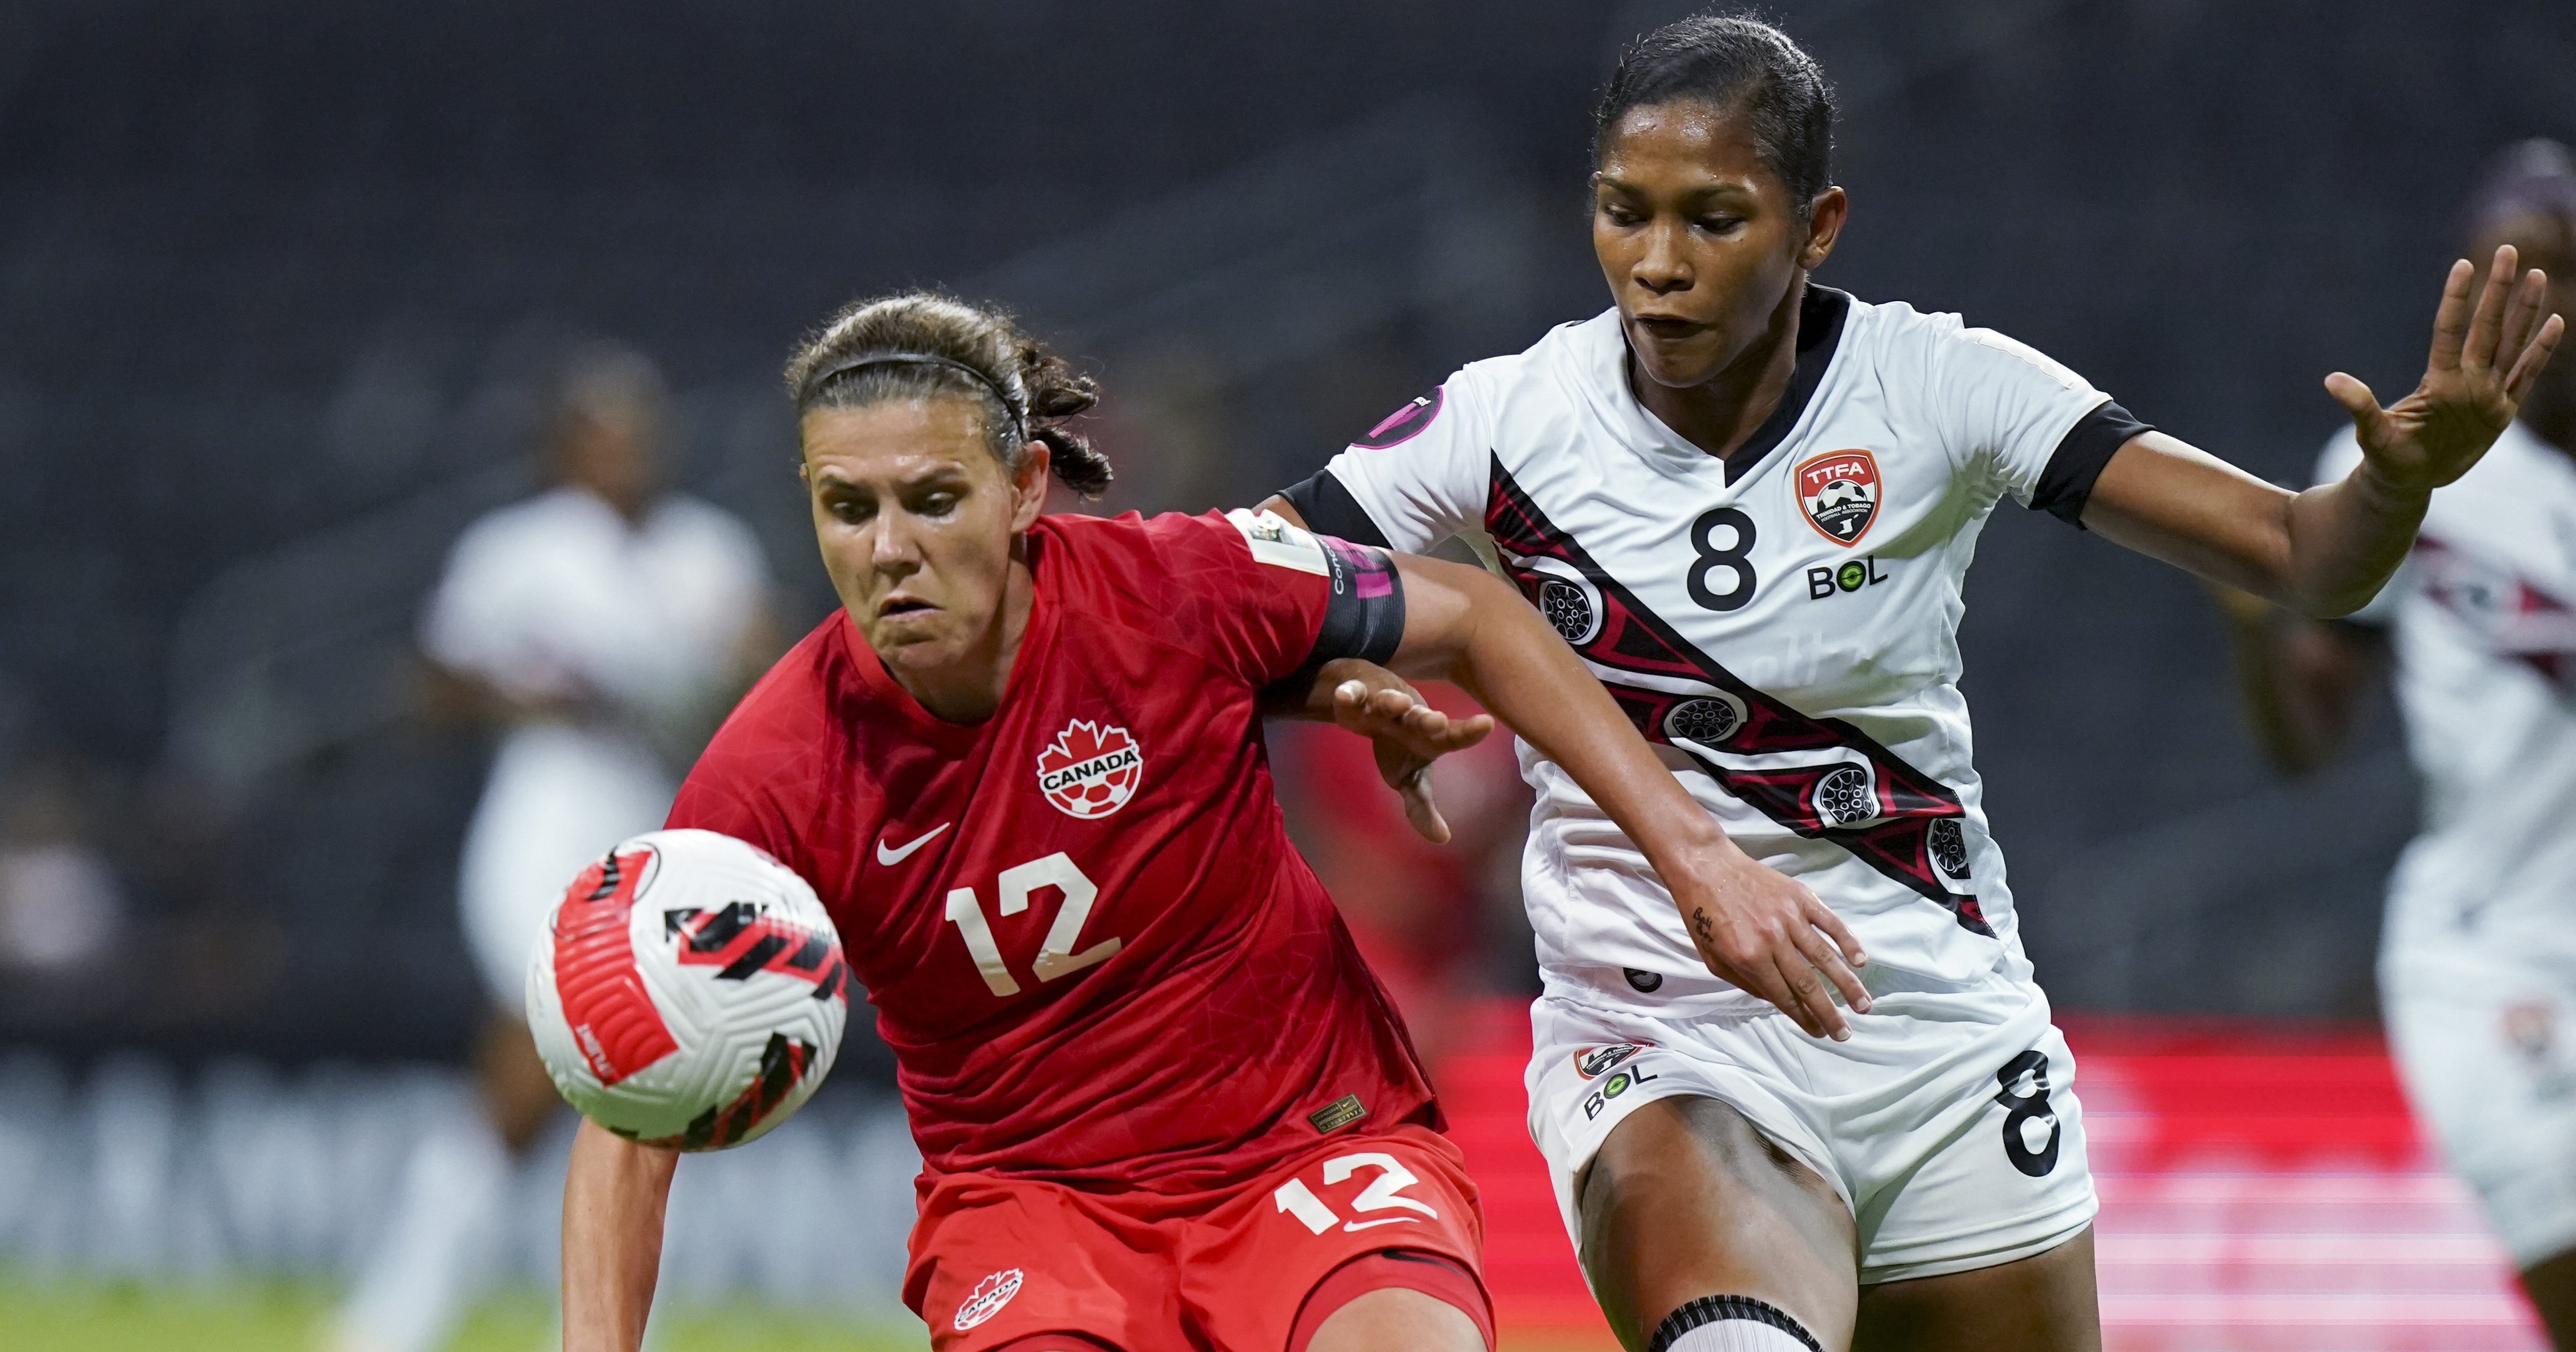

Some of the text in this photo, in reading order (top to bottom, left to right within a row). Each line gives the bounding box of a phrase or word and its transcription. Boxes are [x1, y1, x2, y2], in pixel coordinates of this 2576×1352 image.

[1806, 462, 1865, 484] TTFA
[1816, 506, 1842, 519] TRINIDAD
[1820, 511, 1841, 523] FOOTBALL
[1687, 507, 1757, 611] 8
[1807, 555, 1888, 600] BOL
[1044, 750, 1138, 790] CANADA
[945, 851, 1122, 997] 12
[1584, 1065, 1658, 1121] BOL
[1994, 1050, 2061, 1177] 8
[1274, 1152, 1438, 1236] 12
[957, 1279, 1018, 1322] CANADA
